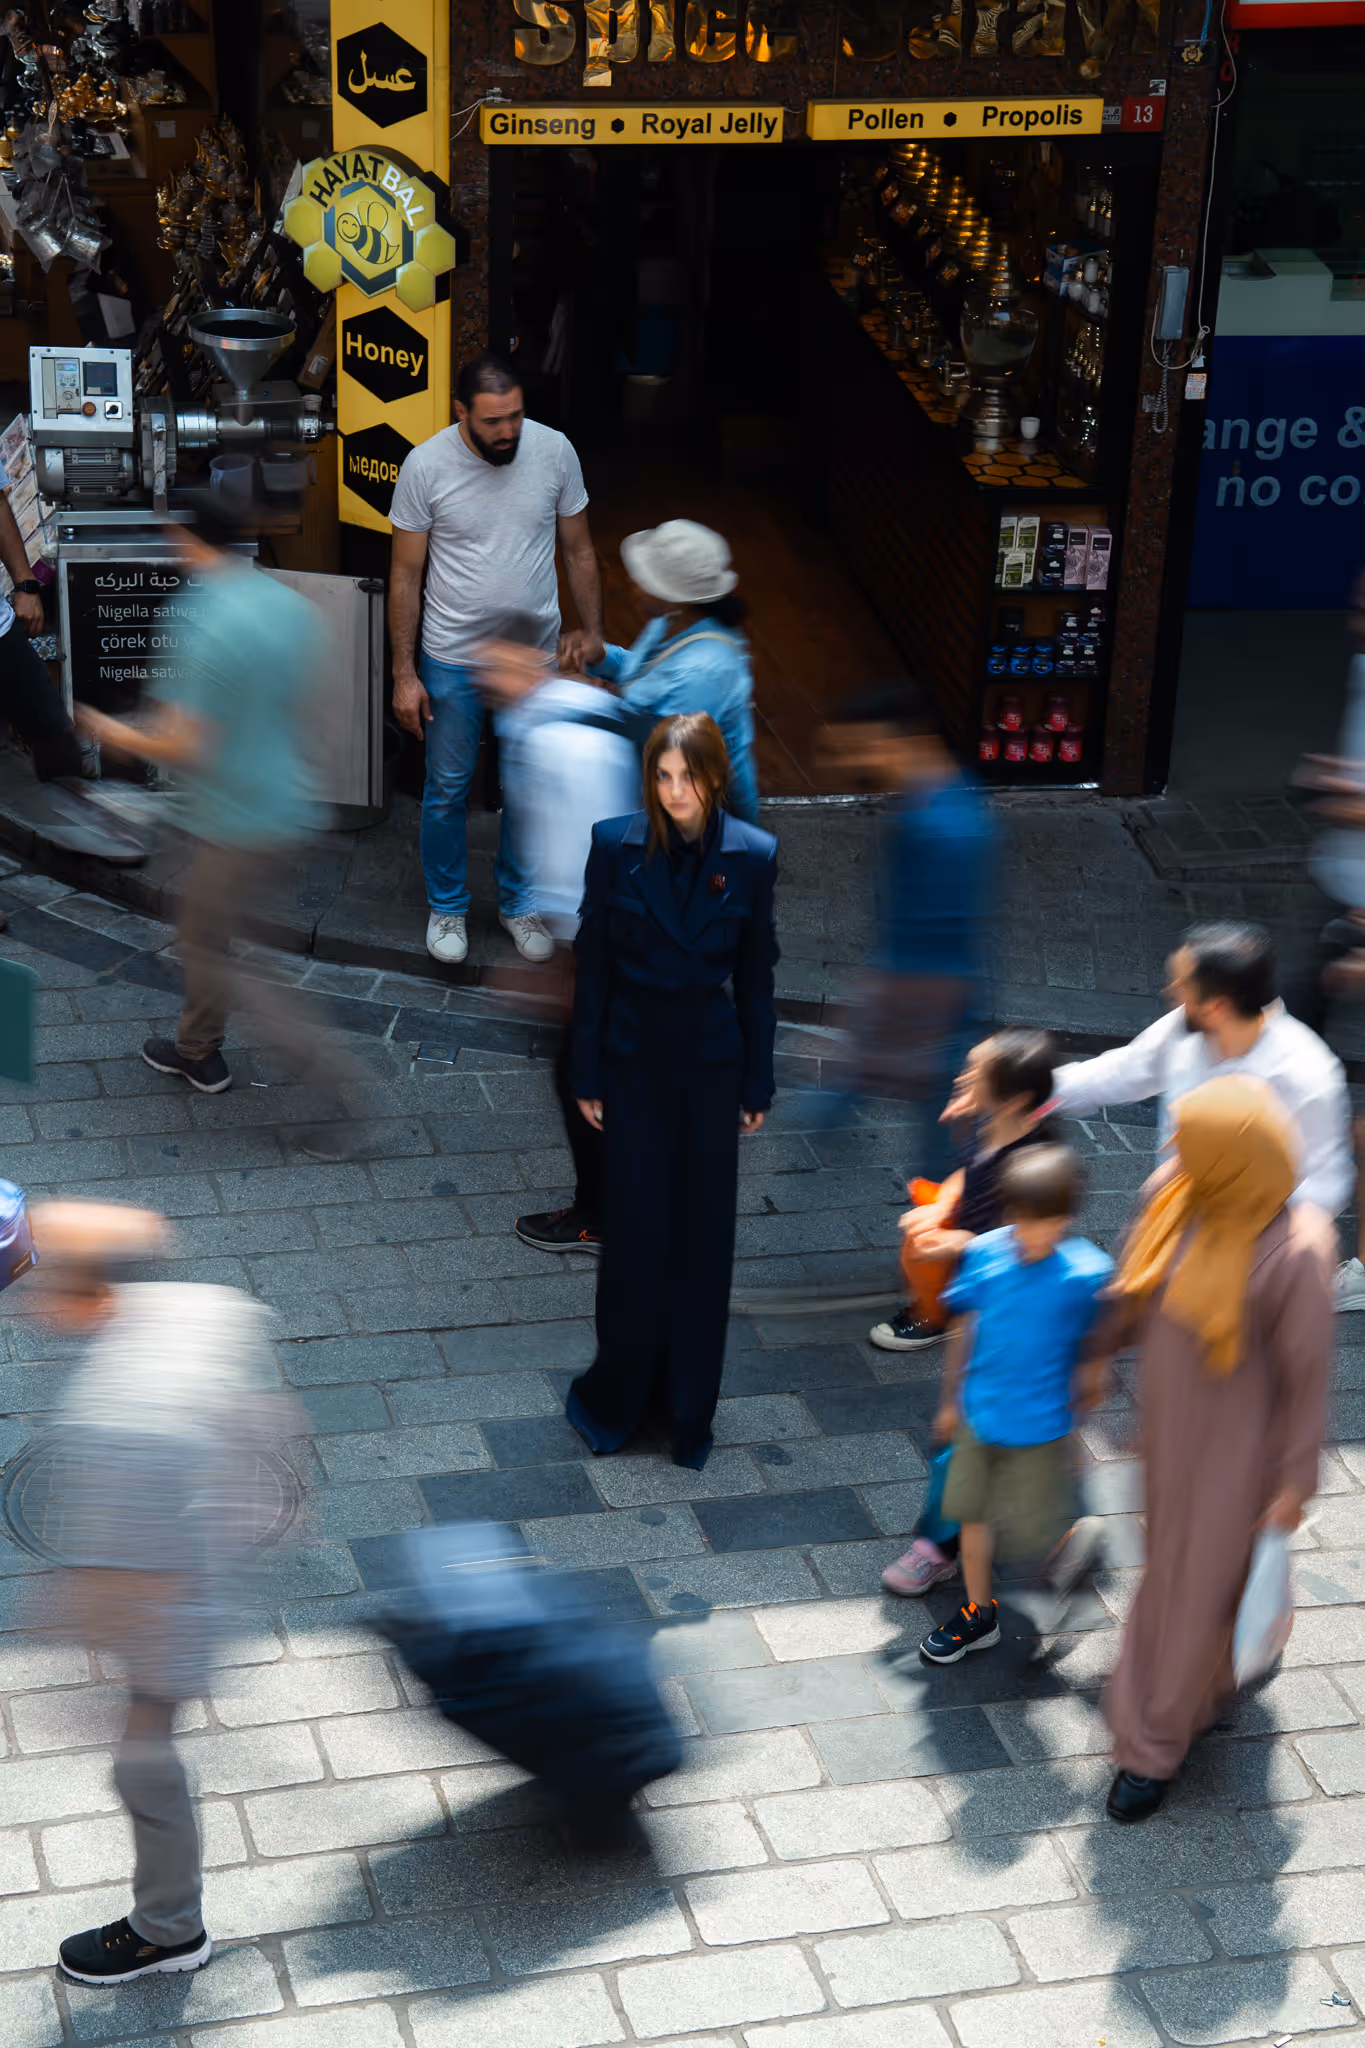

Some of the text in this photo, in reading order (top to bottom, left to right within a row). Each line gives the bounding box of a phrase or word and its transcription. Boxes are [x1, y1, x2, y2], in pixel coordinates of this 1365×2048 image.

[347, 50, 417, 95] عسل
[489, 112, 779, 140] Ginseng Royal Jelly
[848, 105, 1083, 131] Pollen Propolis
[1133, 105, 1154, 124] 13
[346, 331, 425, 377] Honey
[1202, 406, 1365, 461] ange &
[349, 455, 401, 484] медов
[1216, 474, 1365, 507] no co
[150, 572, 180, 592] حبة
[98, 604, 149, 622] Nigella
[153, 605, 197, 618] sativa
[101, 633, 147, 653] çörek
[151, 634, 178, 648] otu
[100, 665, 148, 682] Nigella
